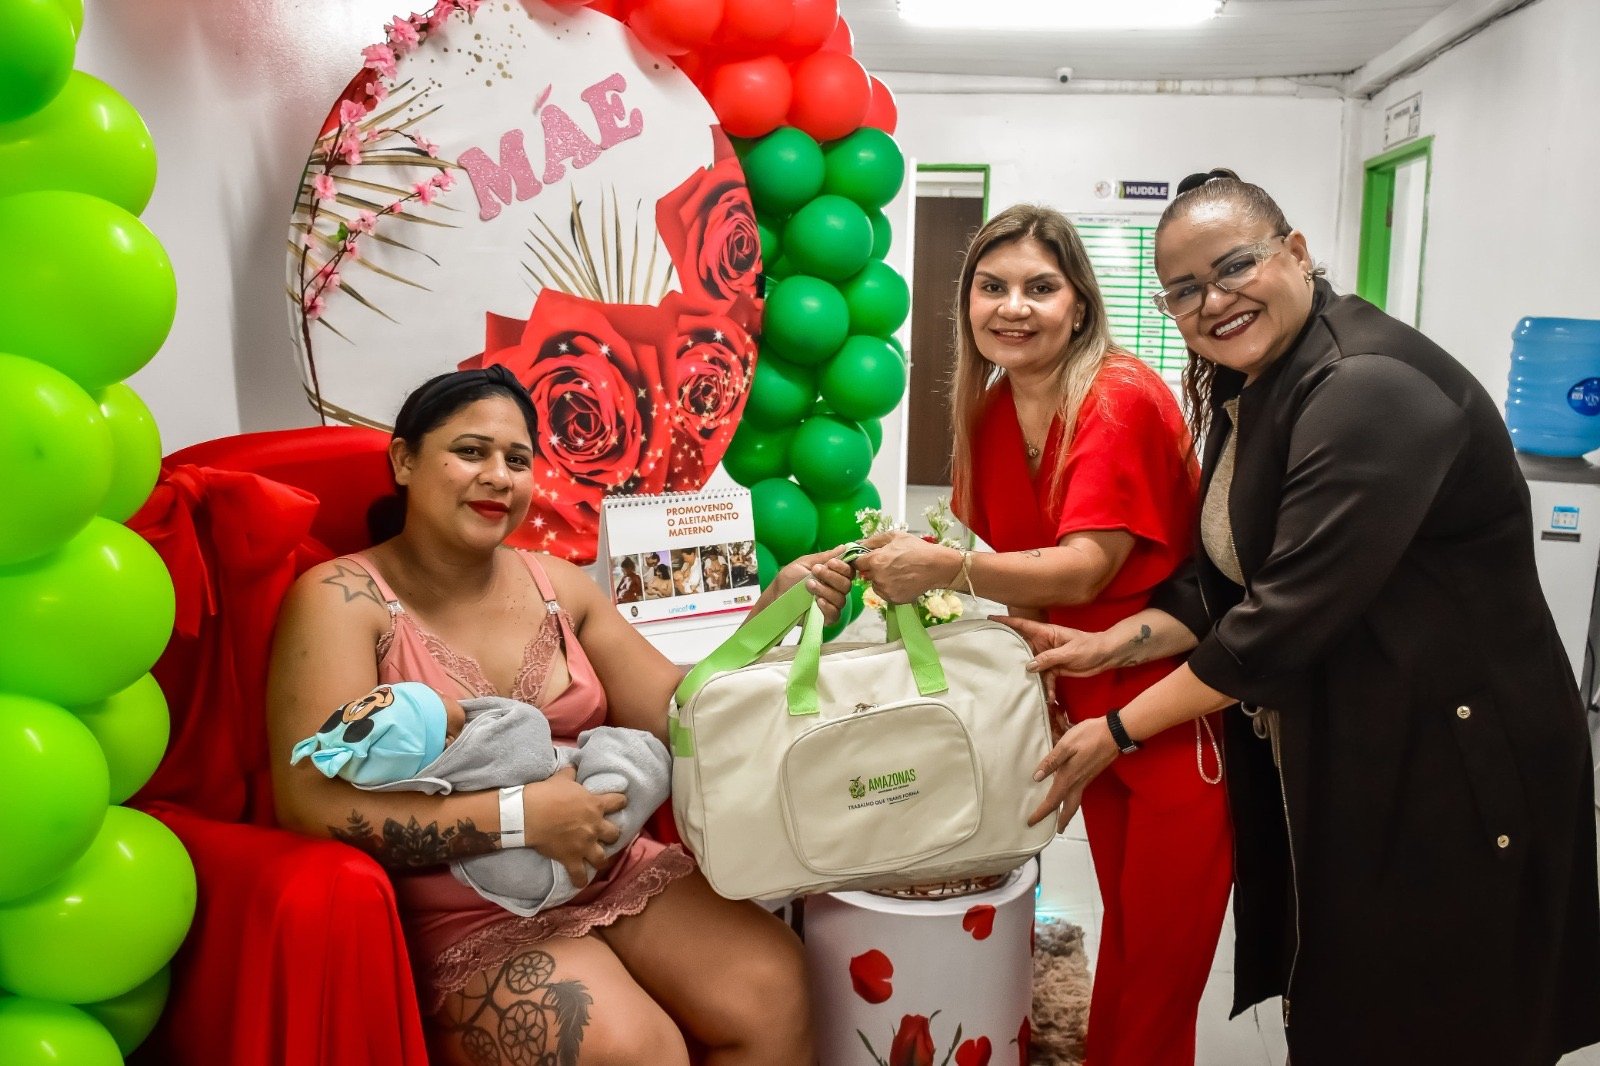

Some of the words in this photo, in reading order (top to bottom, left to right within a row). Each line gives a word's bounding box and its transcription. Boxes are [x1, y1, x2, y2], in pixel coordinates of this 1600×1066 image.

[1125, 185, 1167, 196] HUDDLE
[667, 502, 733, 516] PROMOVENDO
[667, 518, 675, 527] O
[678, 512, 739, 526] ALEITAMENTO
[669, 525, 713, 537] MATERNO
[668, 604, 688, 614] unicef
[868, 768, 916, 791] AMAZONAS
[874, 798, 885, 806] QUE
